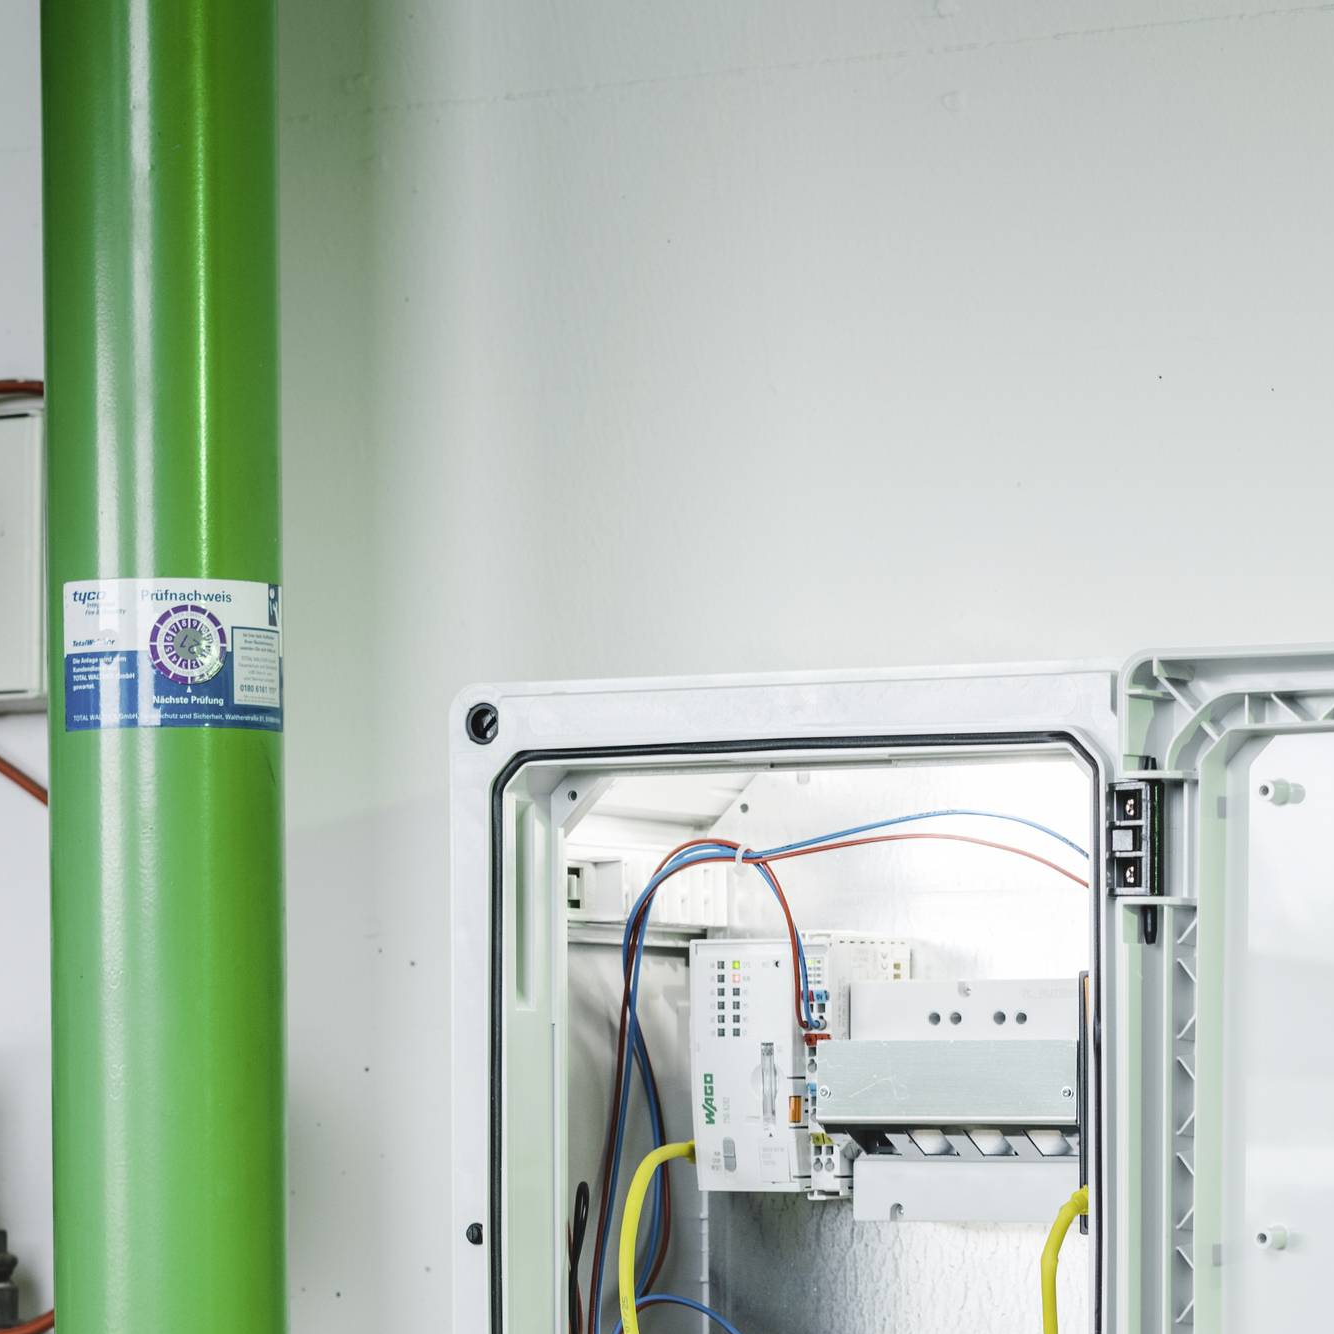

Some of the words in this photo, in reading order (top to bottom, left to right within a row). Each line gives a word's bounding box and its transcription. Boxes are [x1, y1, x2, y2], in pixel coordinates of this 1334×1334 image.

[141, 588, 233, 603] Prüfnachweis
[153, 695, 189, 705] Nächste
[191, 695, 225, 706] Prüfung
[701, 1073, 718, 1125] WAGO
